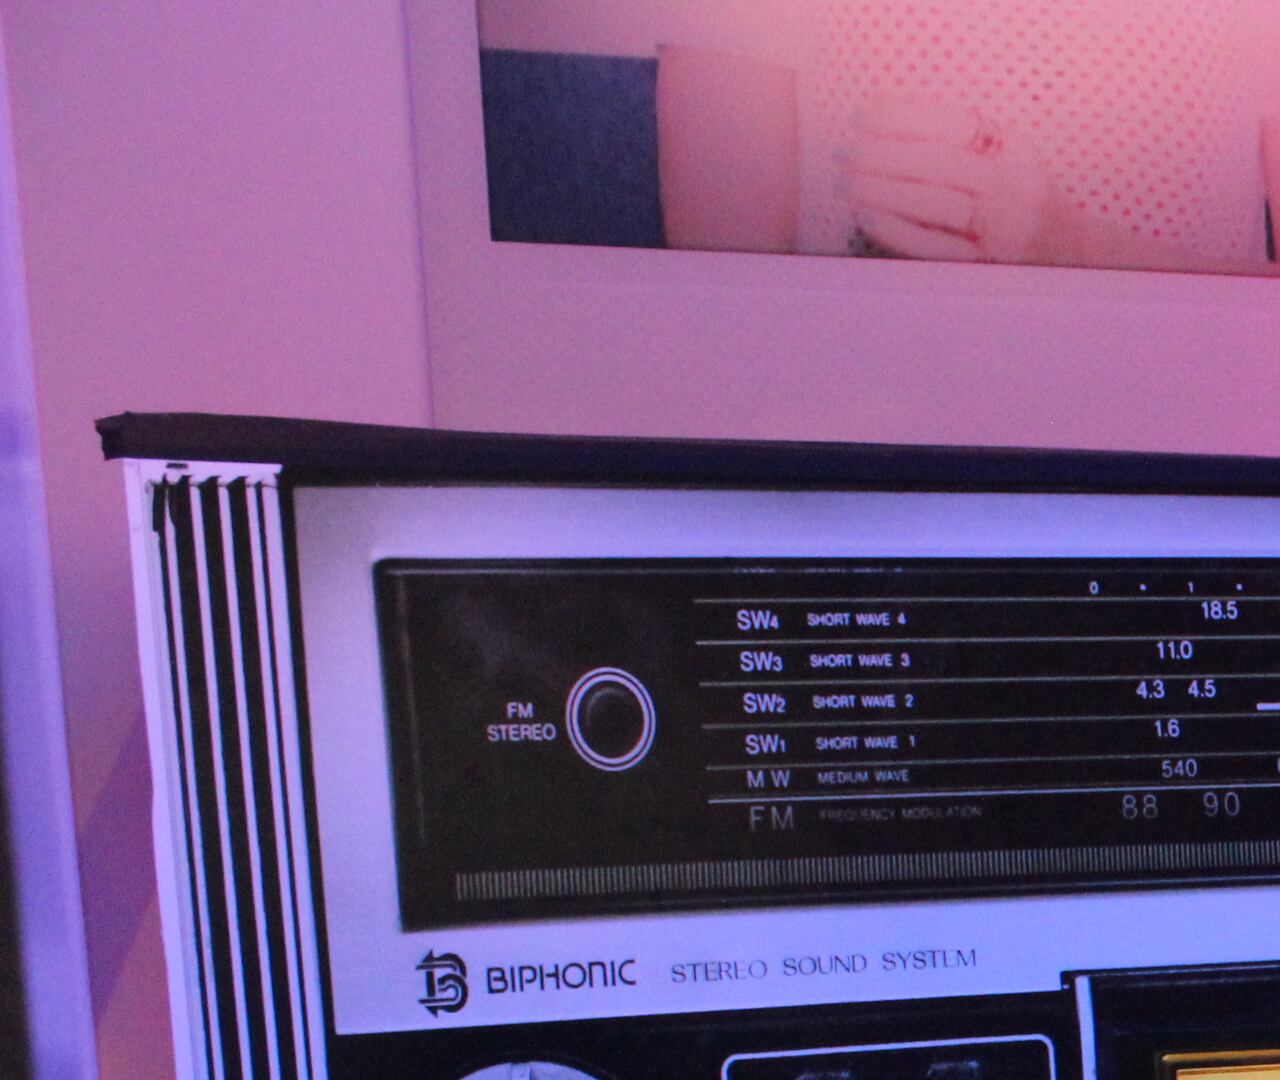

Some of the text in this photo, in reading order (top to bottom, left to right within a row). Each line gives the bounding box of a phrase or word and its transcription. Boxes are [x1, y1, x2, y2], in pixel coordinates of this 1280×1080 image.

[1089, 582, 1098, 594] 0
[737, 609, 906, 630] SW4 SHORT WAVE 4
[1201, 602, 1238, 619] 18.5
[1156, 641, 1193, 659] 11.0
[740, 652, 910, 672] SW3 SHORT WAVE 3
[1136, 681, 1165, 699] 4.3
[1189, 680, 1216, 698] 4.5
[507, 702, 533, 718] FM
[743, 693, 914, 714] SW2 SHORT WAVE 2
[487, 724, 557, 742] STEREO
[1155, 720, 1180, 738] 1.6
[745, 734, 915, 755] SW1 SHORT WAVE 1
[818, 772, 868, 784] MEDIUM
[875, 770, 909, 782] WAVE
[1162, 759, 1197, 778] 540
[1122, 795, 1158, 820] 88
[1203, 792, 1240, 817] 90
[486, 949, 976, 994] BIPHONIC STEREO SOUND SYSTEM
